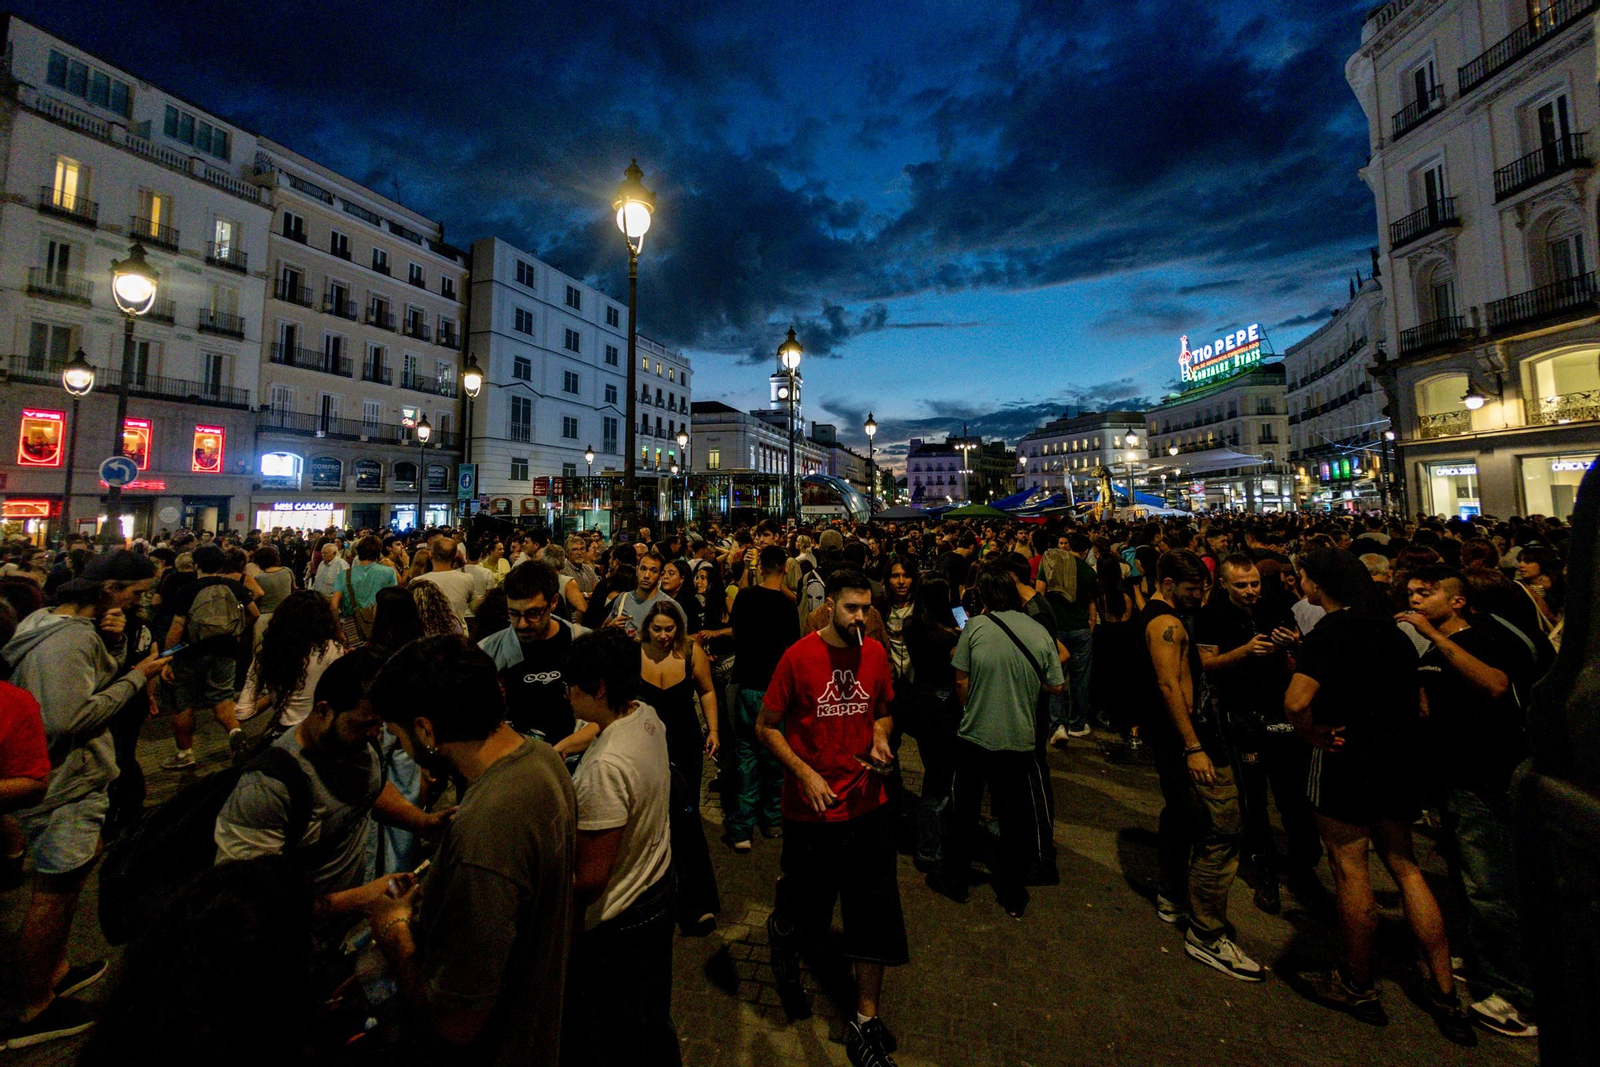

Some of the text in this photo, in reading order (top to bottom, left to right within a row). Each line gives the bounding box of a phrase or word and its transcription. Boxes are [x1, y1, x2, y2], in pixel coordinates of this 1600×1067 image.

[1192, 323, 1259, 364] TIO PEPE
[1193, 349, 1260, 382] GONZALEZ BYASS
[23, 411, 61, 420] VIPS
[313, 463, 340, 471] COMPRO
[274, 503, 334, 511] MISS CARCASAS
[817, 702, 868, 717] Kappa
